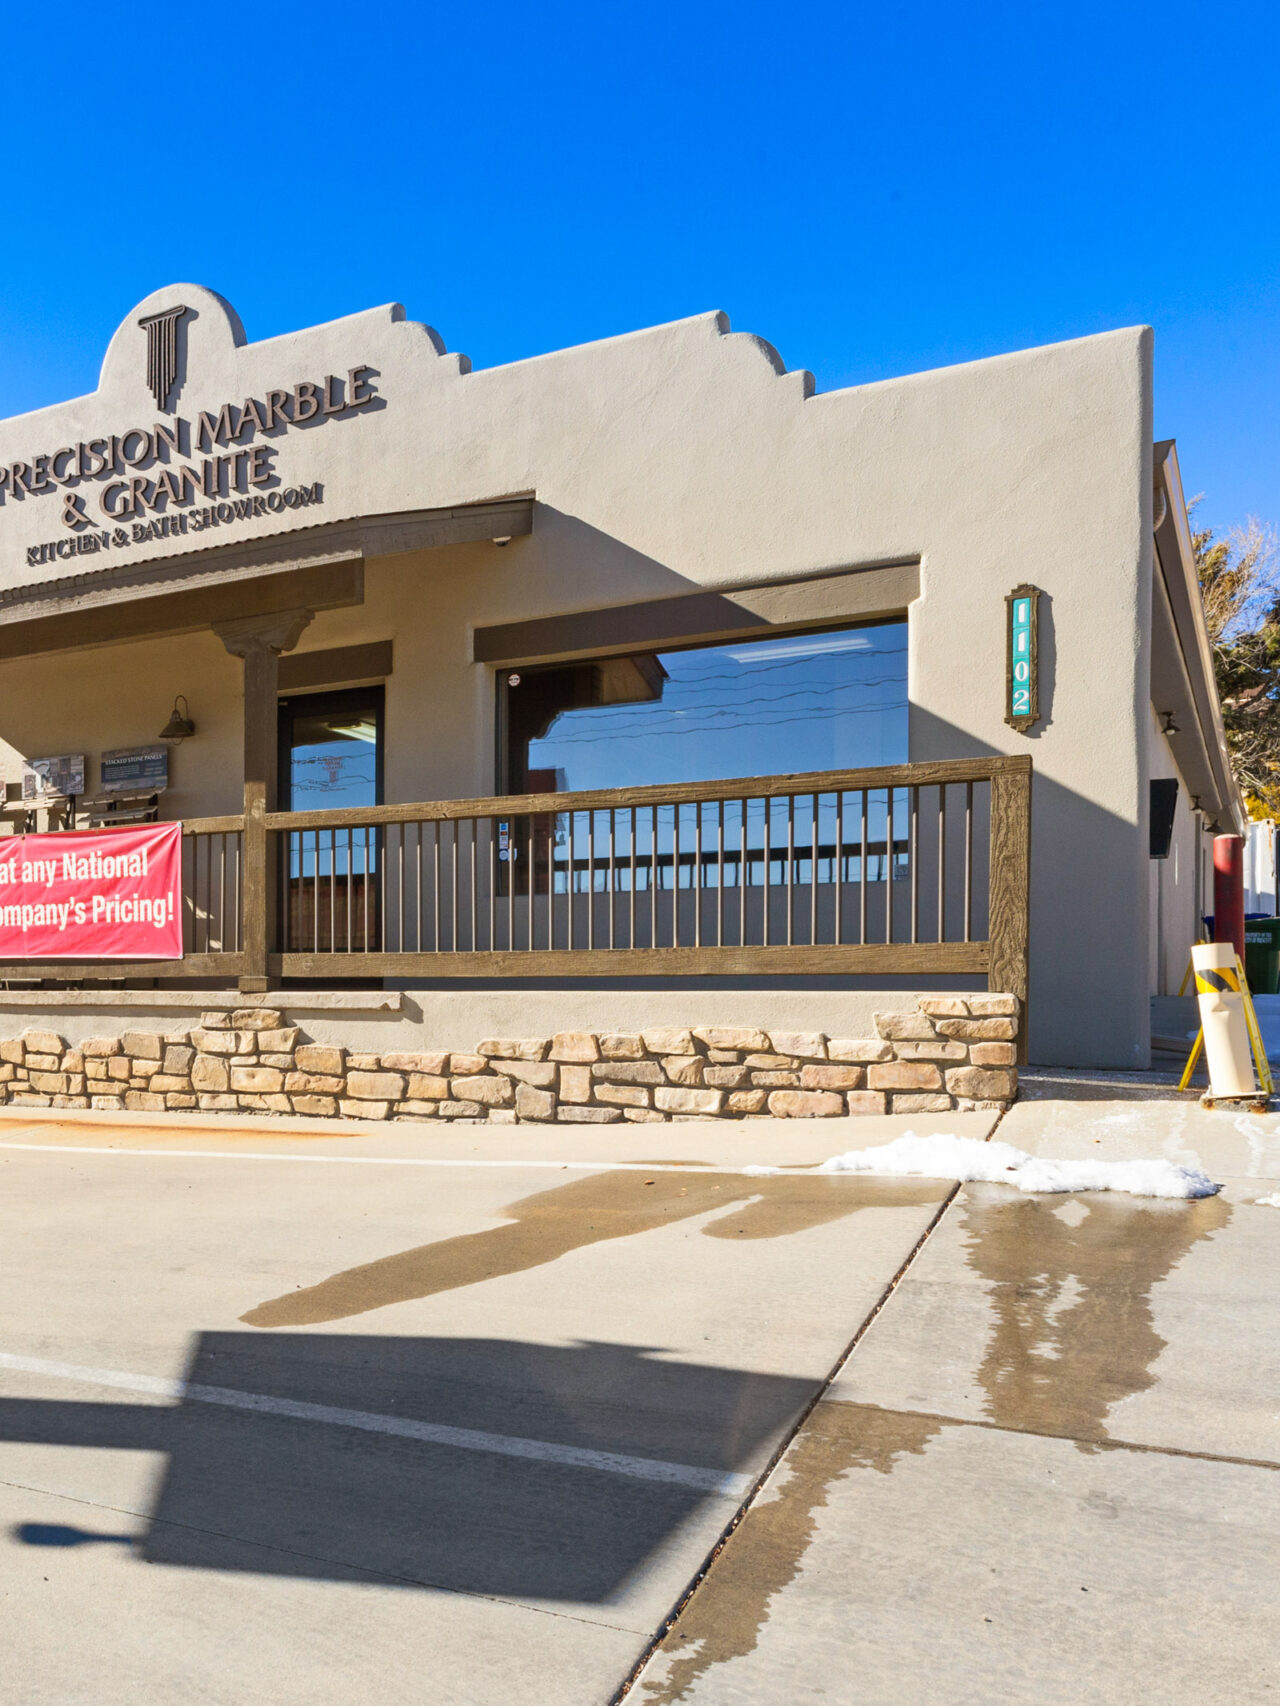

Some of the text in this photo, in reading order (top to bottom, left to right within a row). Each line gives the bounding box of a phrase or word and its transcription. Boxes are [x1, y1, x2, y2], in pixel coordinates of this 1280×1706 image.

[196, 365, 374, 450] MARBLE
[26, 481, 321, 566] KITCHEN & BATH SHOWROOM
[60, 444, 272, 529] & GRANITE
[21, 857, 57, 888] any
[62, 848, 149, 880] National
[92, 892, 175, 928] Pricing!
